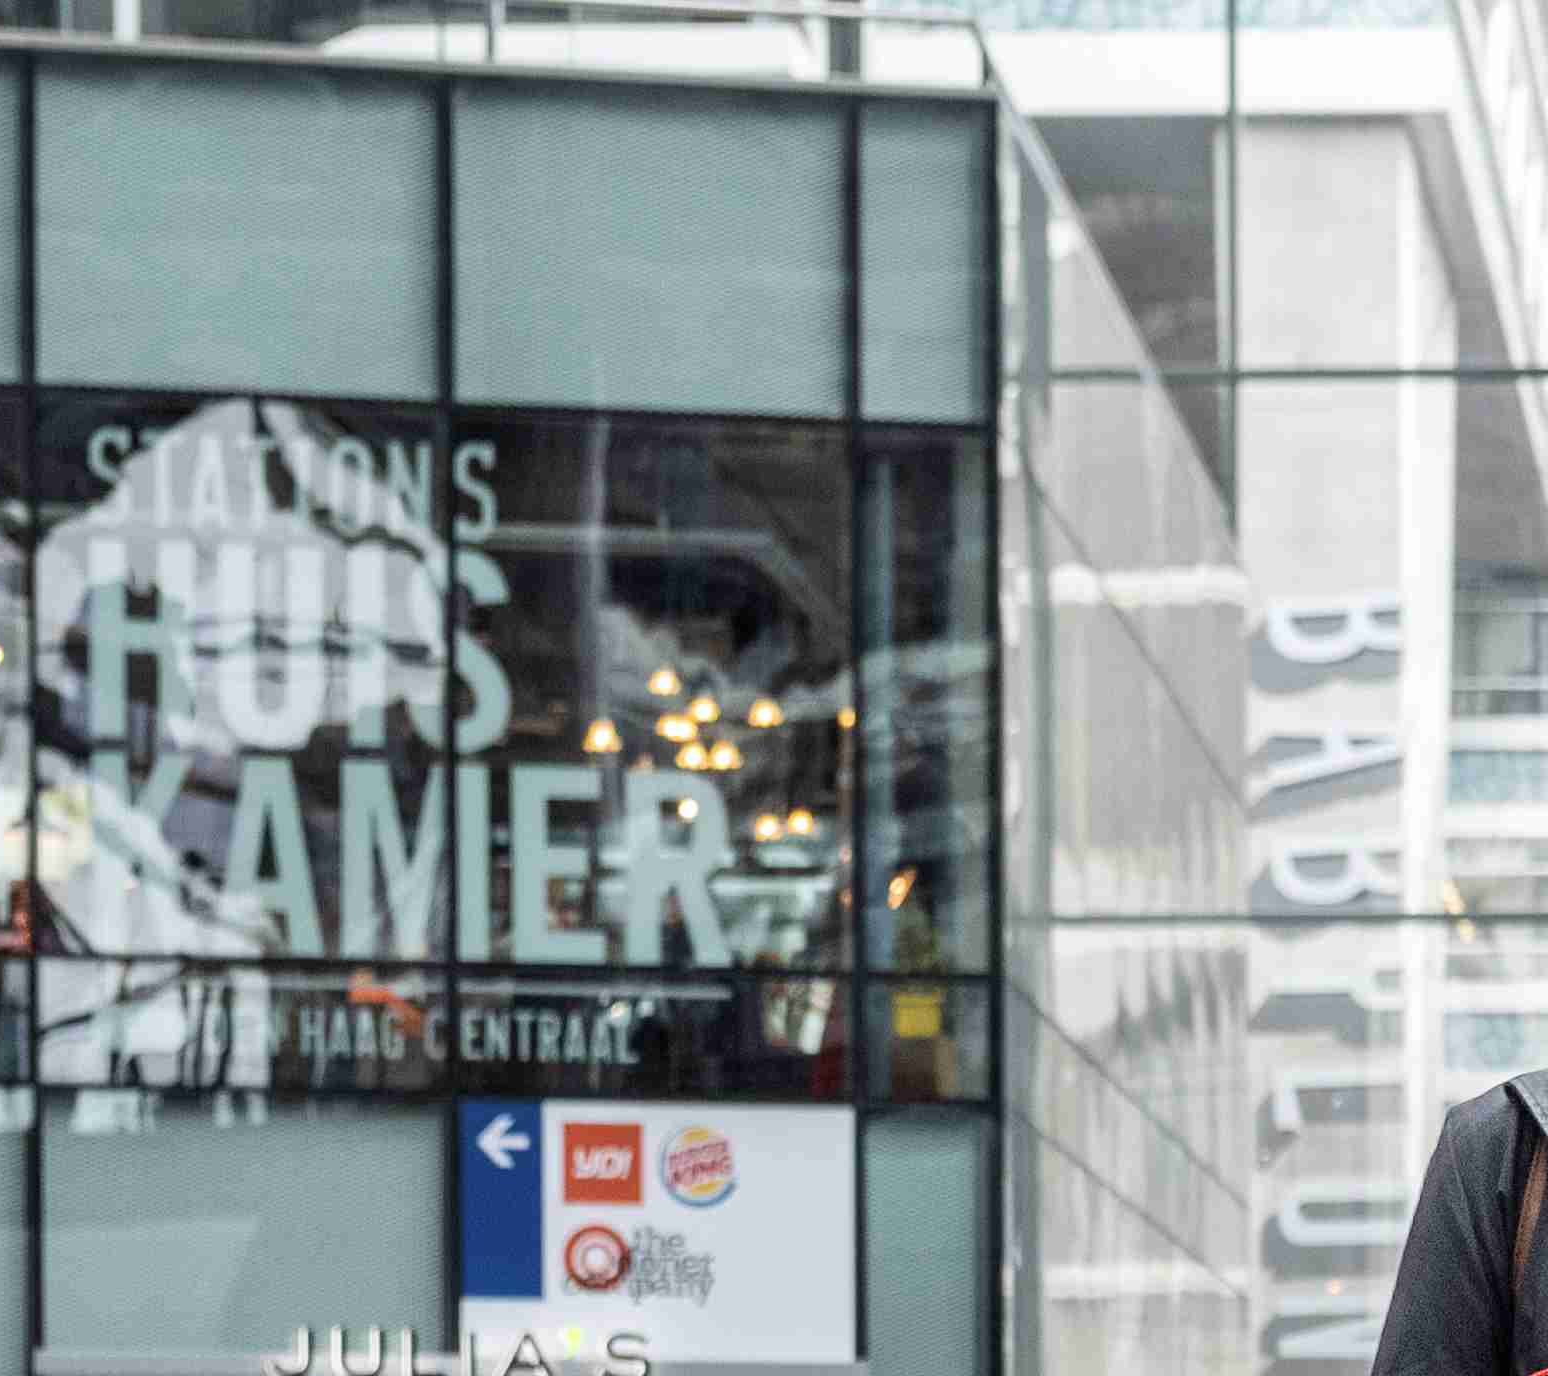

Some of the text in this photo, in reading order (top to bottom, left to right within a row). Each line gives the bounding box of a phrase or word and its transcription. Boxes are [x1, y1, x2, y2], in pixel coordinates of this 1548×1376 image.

[88, 427, 498, 545] STATIONS
[87, 535, 512, 756] HUIS
[87, 752, 733, 968] KAMER
[298, 1006, 406, 1061] HAAG
[423, 1004, 640, 1067] CENTRAAL
